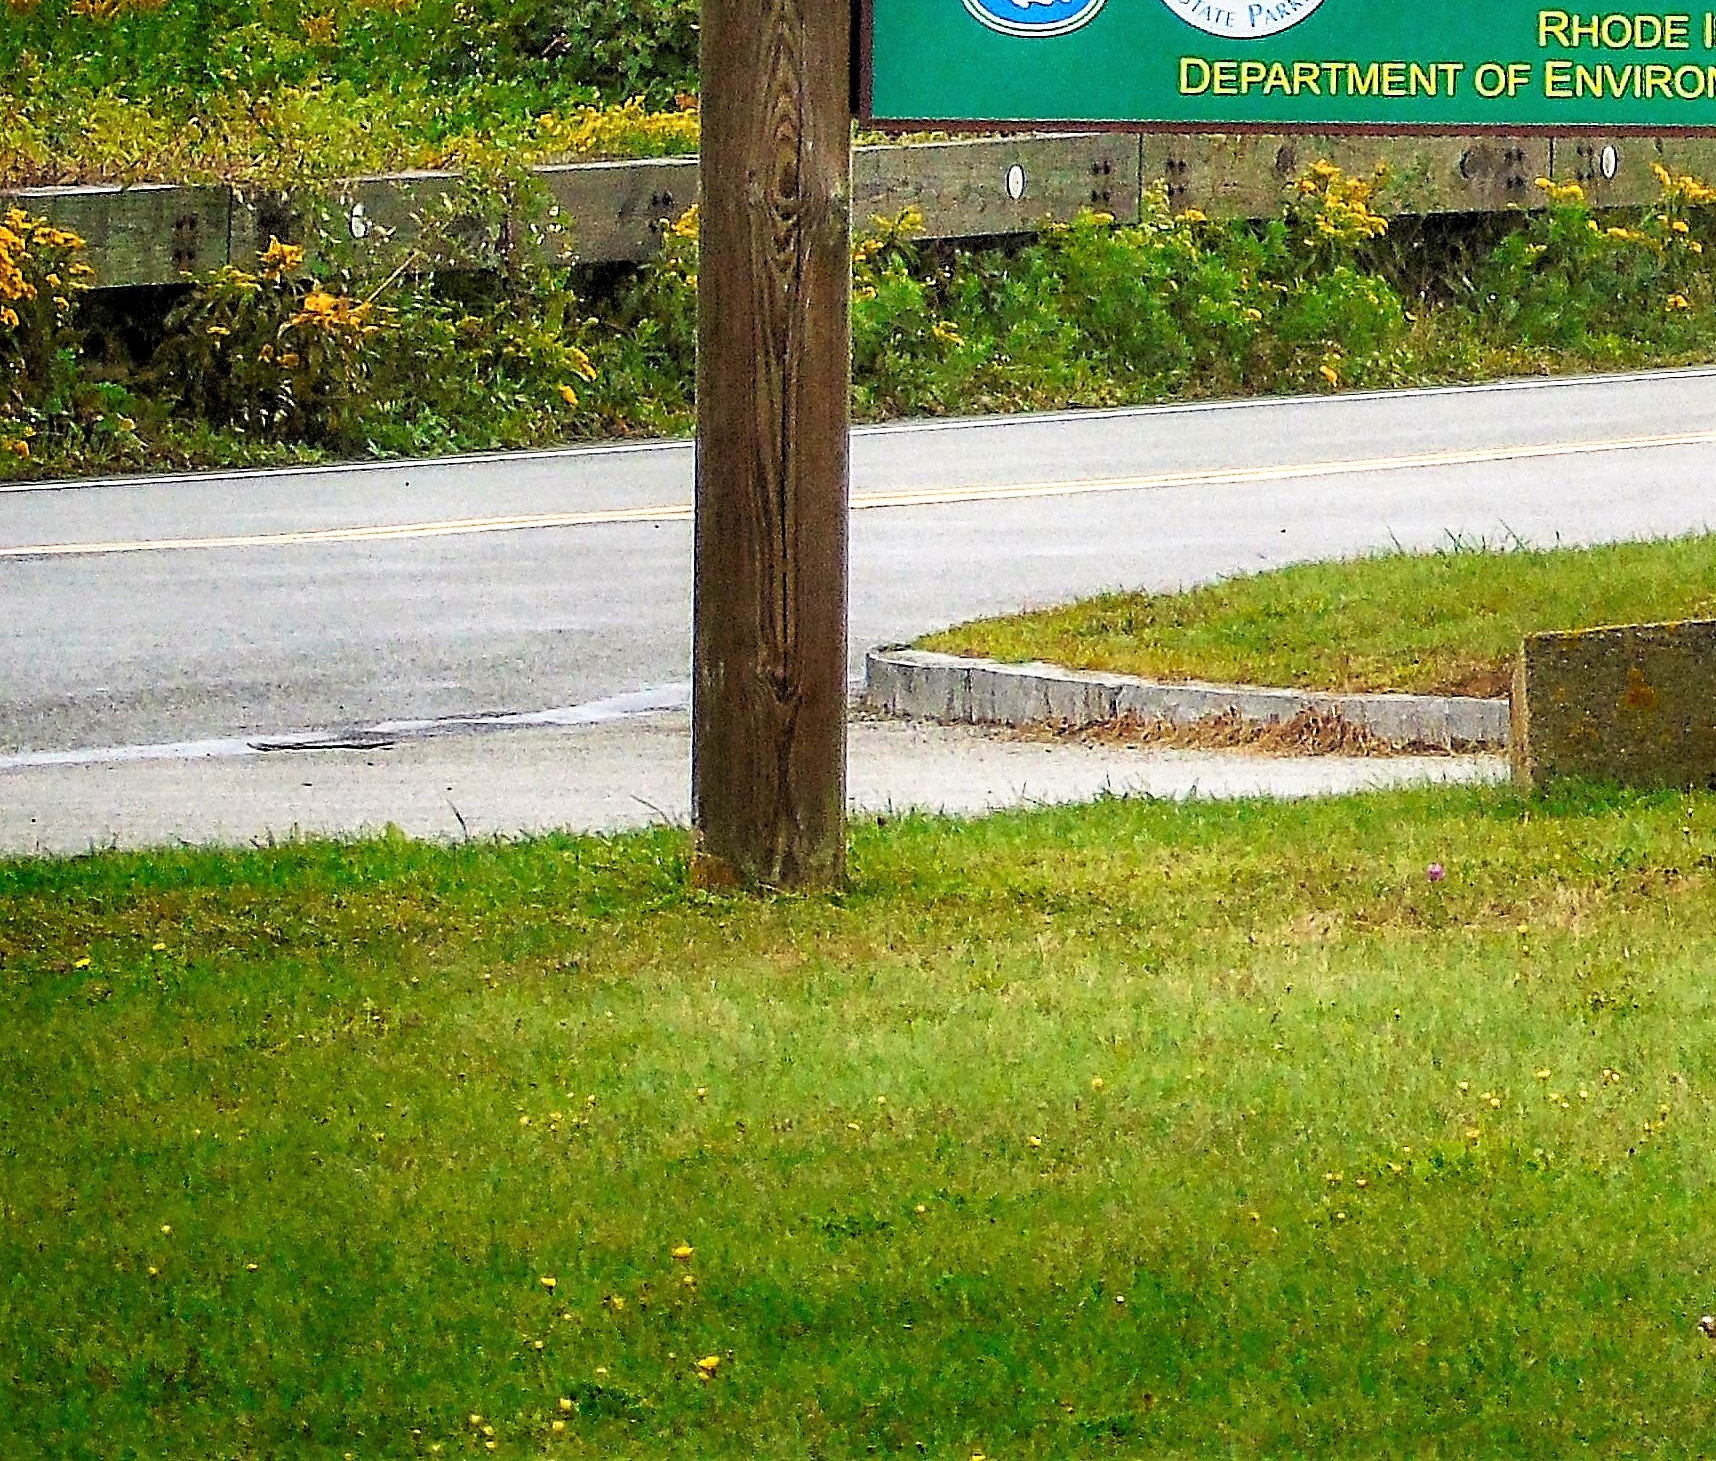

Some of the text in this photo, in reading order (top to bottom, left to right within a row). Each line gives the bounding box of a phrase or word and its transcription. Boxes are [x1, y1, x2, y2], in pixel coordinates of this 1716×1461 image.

[1536, 10, 1690, 50] RHODE
[1177, 56, 1462, 98] DEPARTMENT
[1472, 63, 1532, 98] OF
